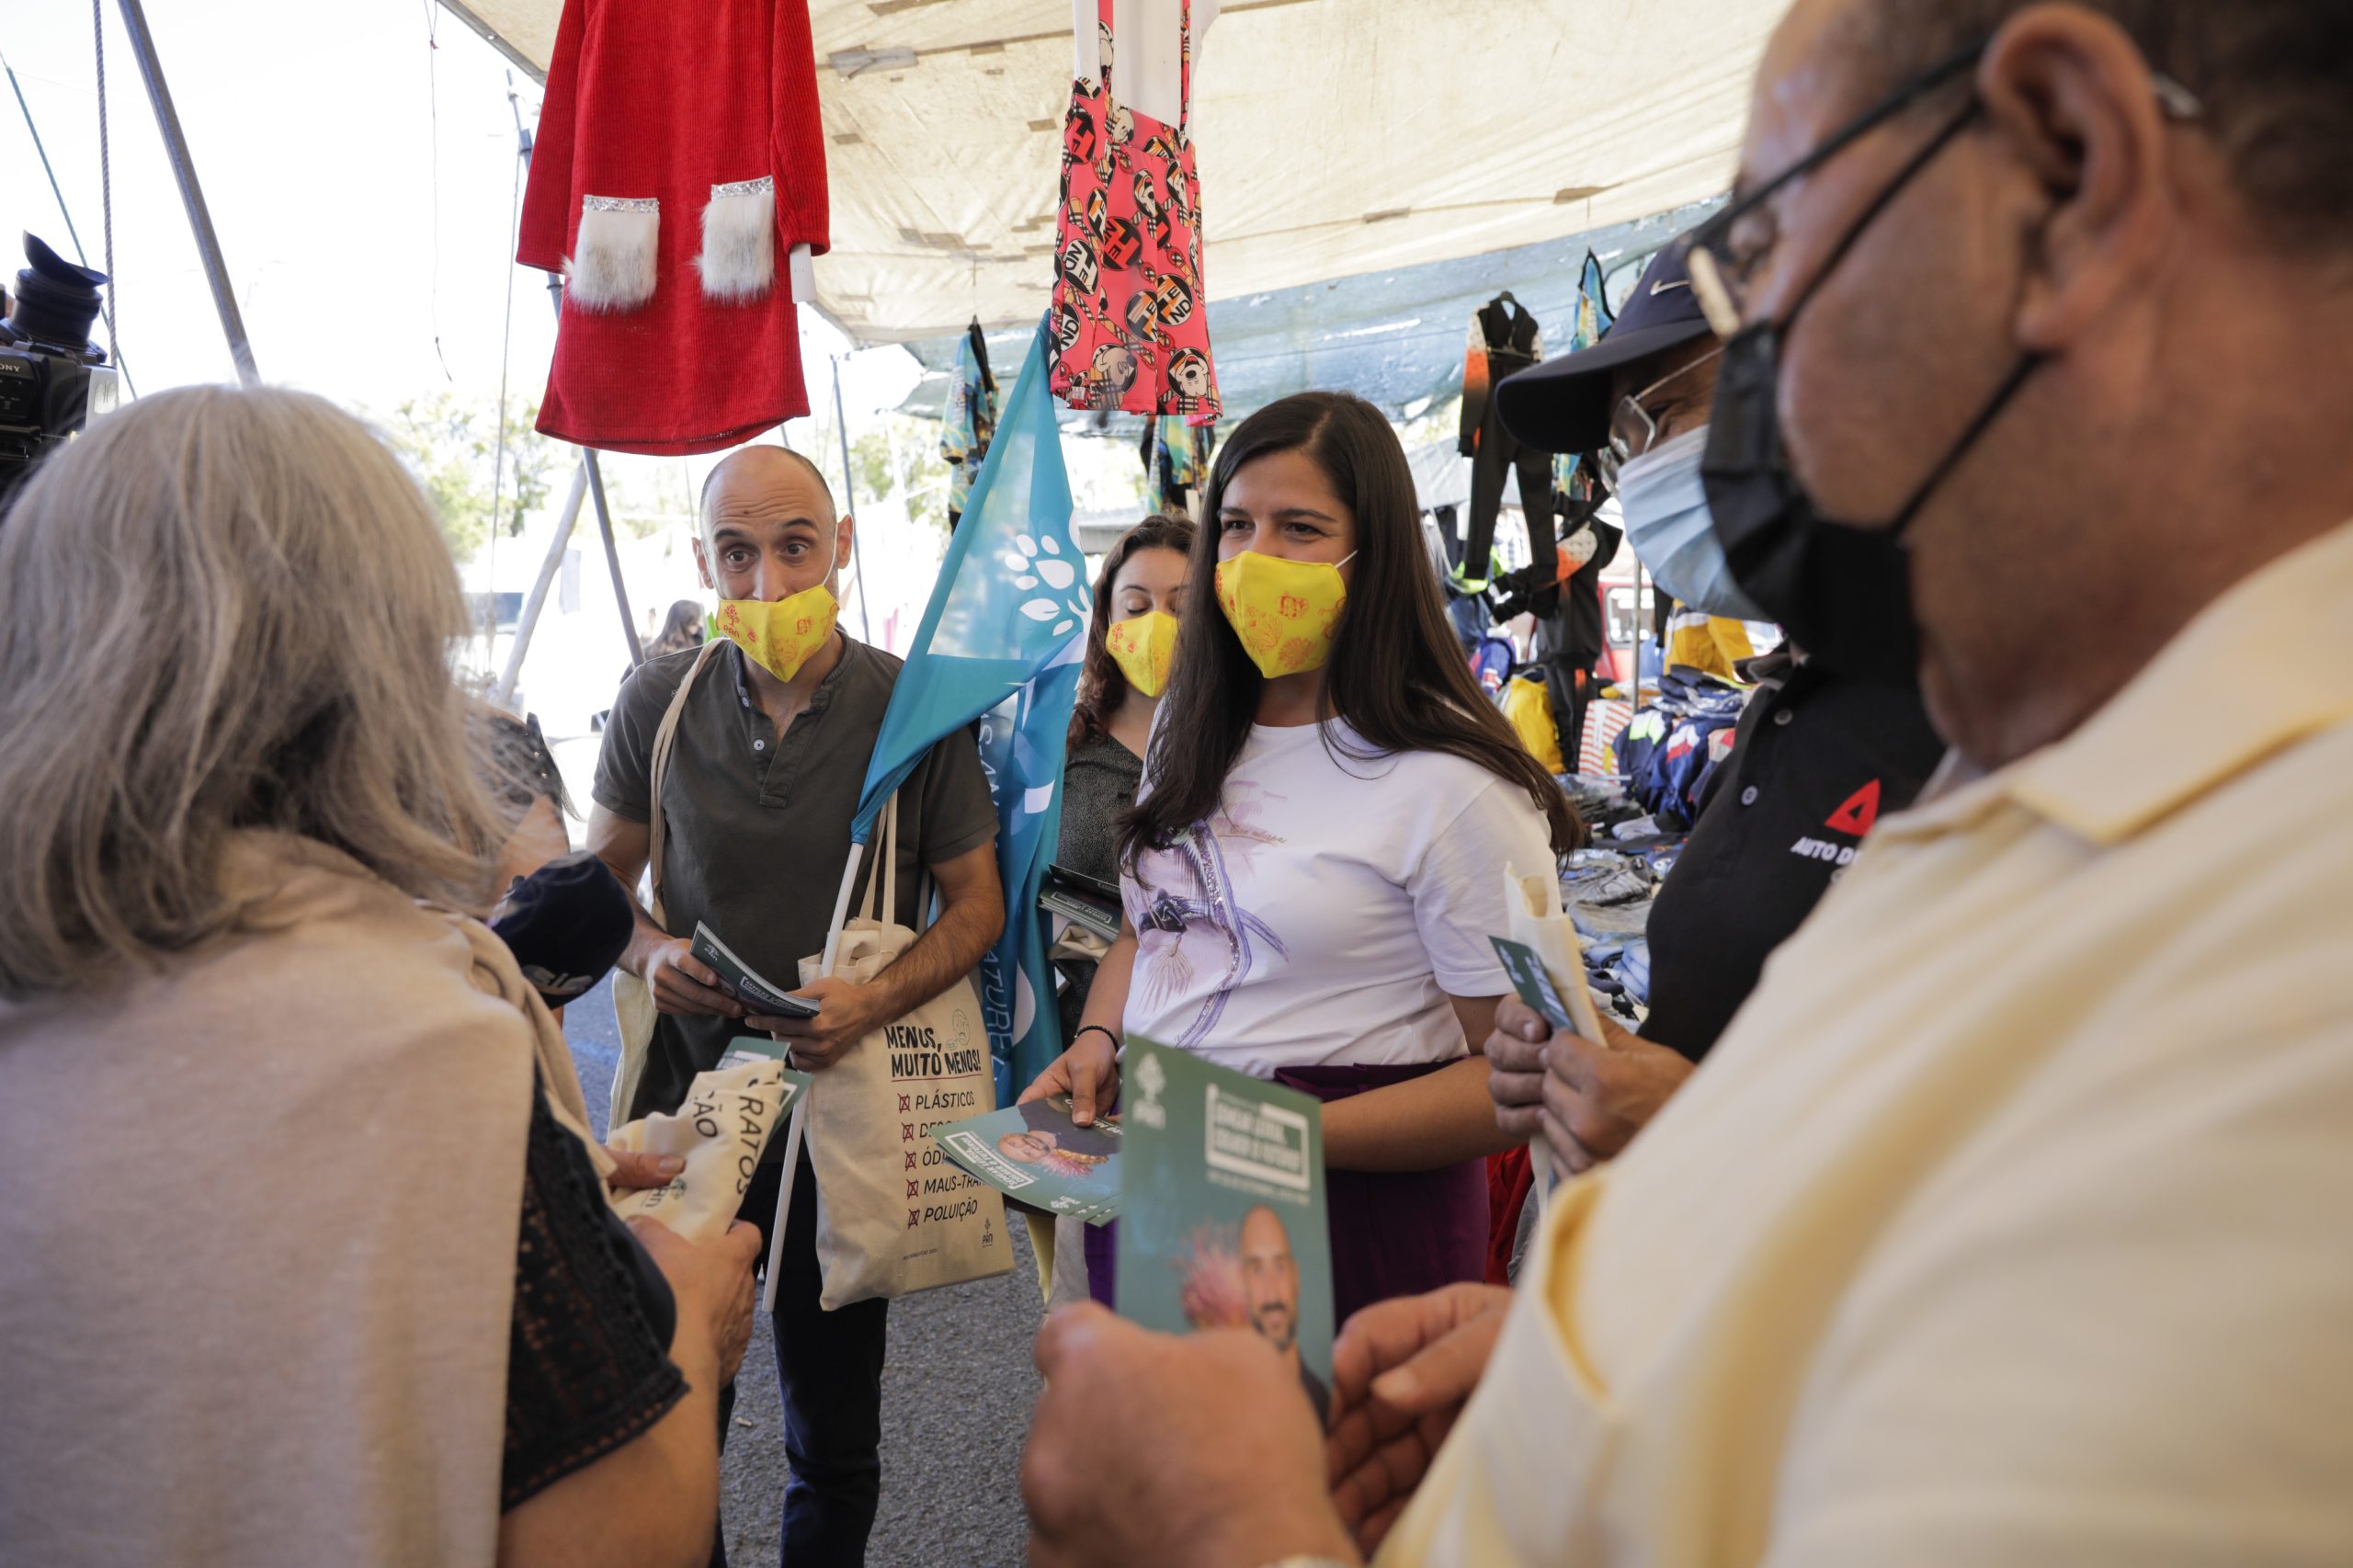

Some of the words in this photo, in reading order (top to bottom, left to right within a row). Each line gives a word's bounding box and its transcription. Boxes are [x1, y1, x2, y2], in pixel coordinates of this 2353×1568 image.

[0, 362, 20, 372] ONY
[983, 941, 1015, 1068] ATURE
[883, 1025, 942, 1053] MENOS,
[891, 1052, 942, 1077] MUITO
[944, 1049, 982, 1075] MENOS!
[915, 1088, 975, 1110] PLÁSTICOS
[923, 1197, 979, 1223] POLUIÇÃO
